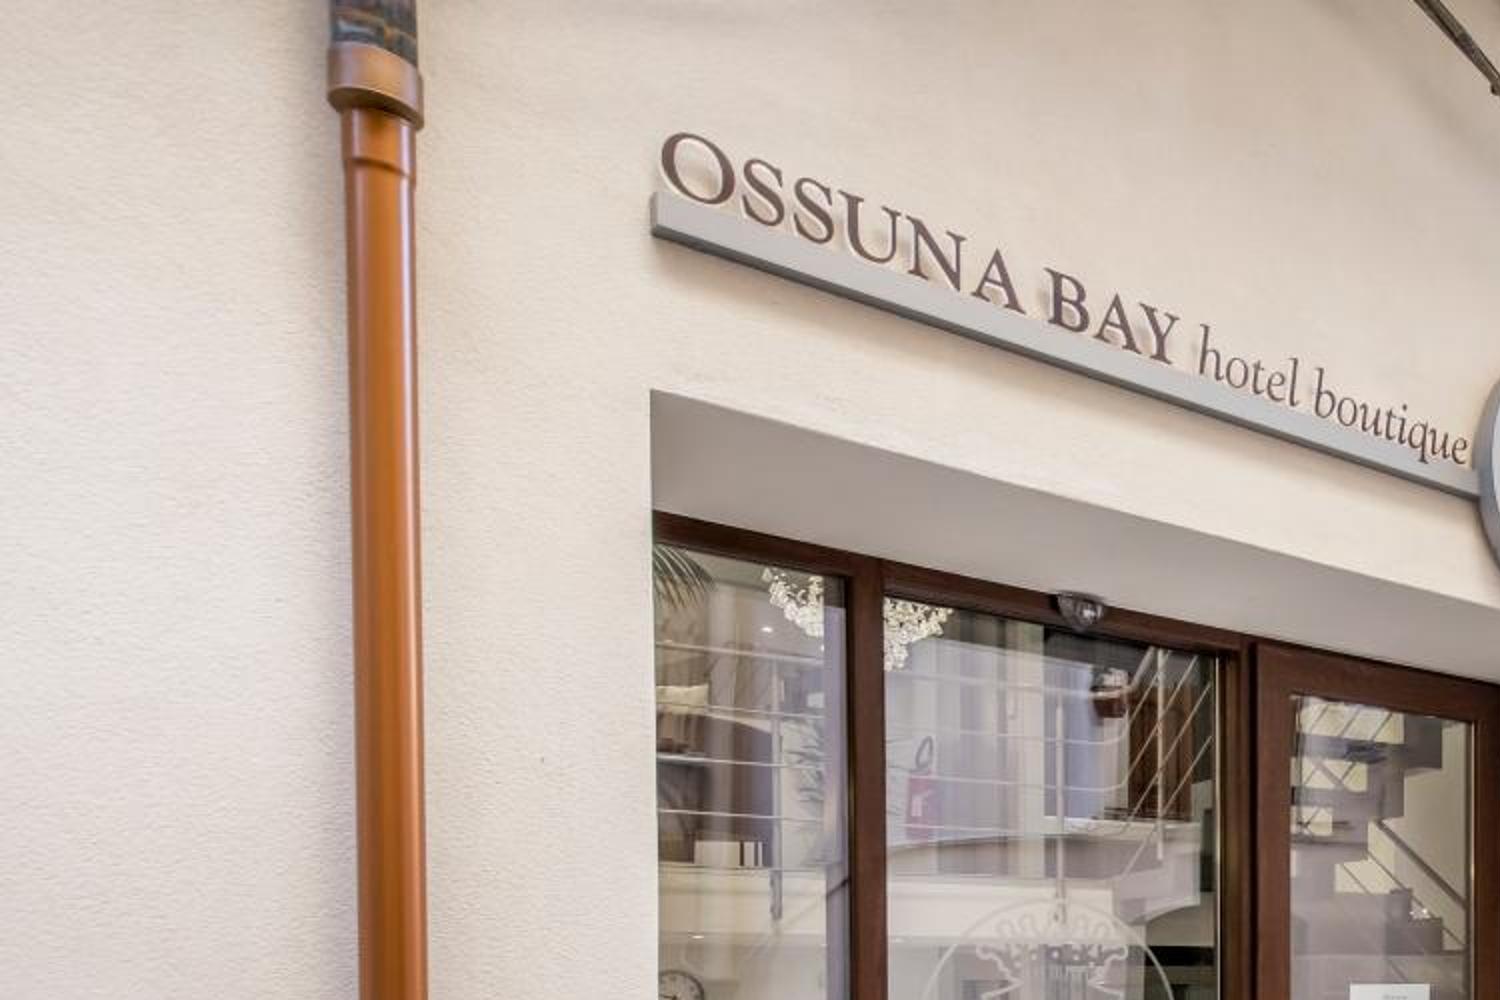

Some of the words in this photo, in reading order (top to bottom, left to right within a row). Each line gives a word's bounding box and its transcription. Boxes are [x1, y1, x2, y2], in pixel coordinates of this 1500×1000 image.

[660, 132, 1026, 315] OSSUNA
[1044, 267, 1180, 365] BAY
[1197, 323, 1300, 408] hotel
[1314, 368, 1470, 466] boutique
